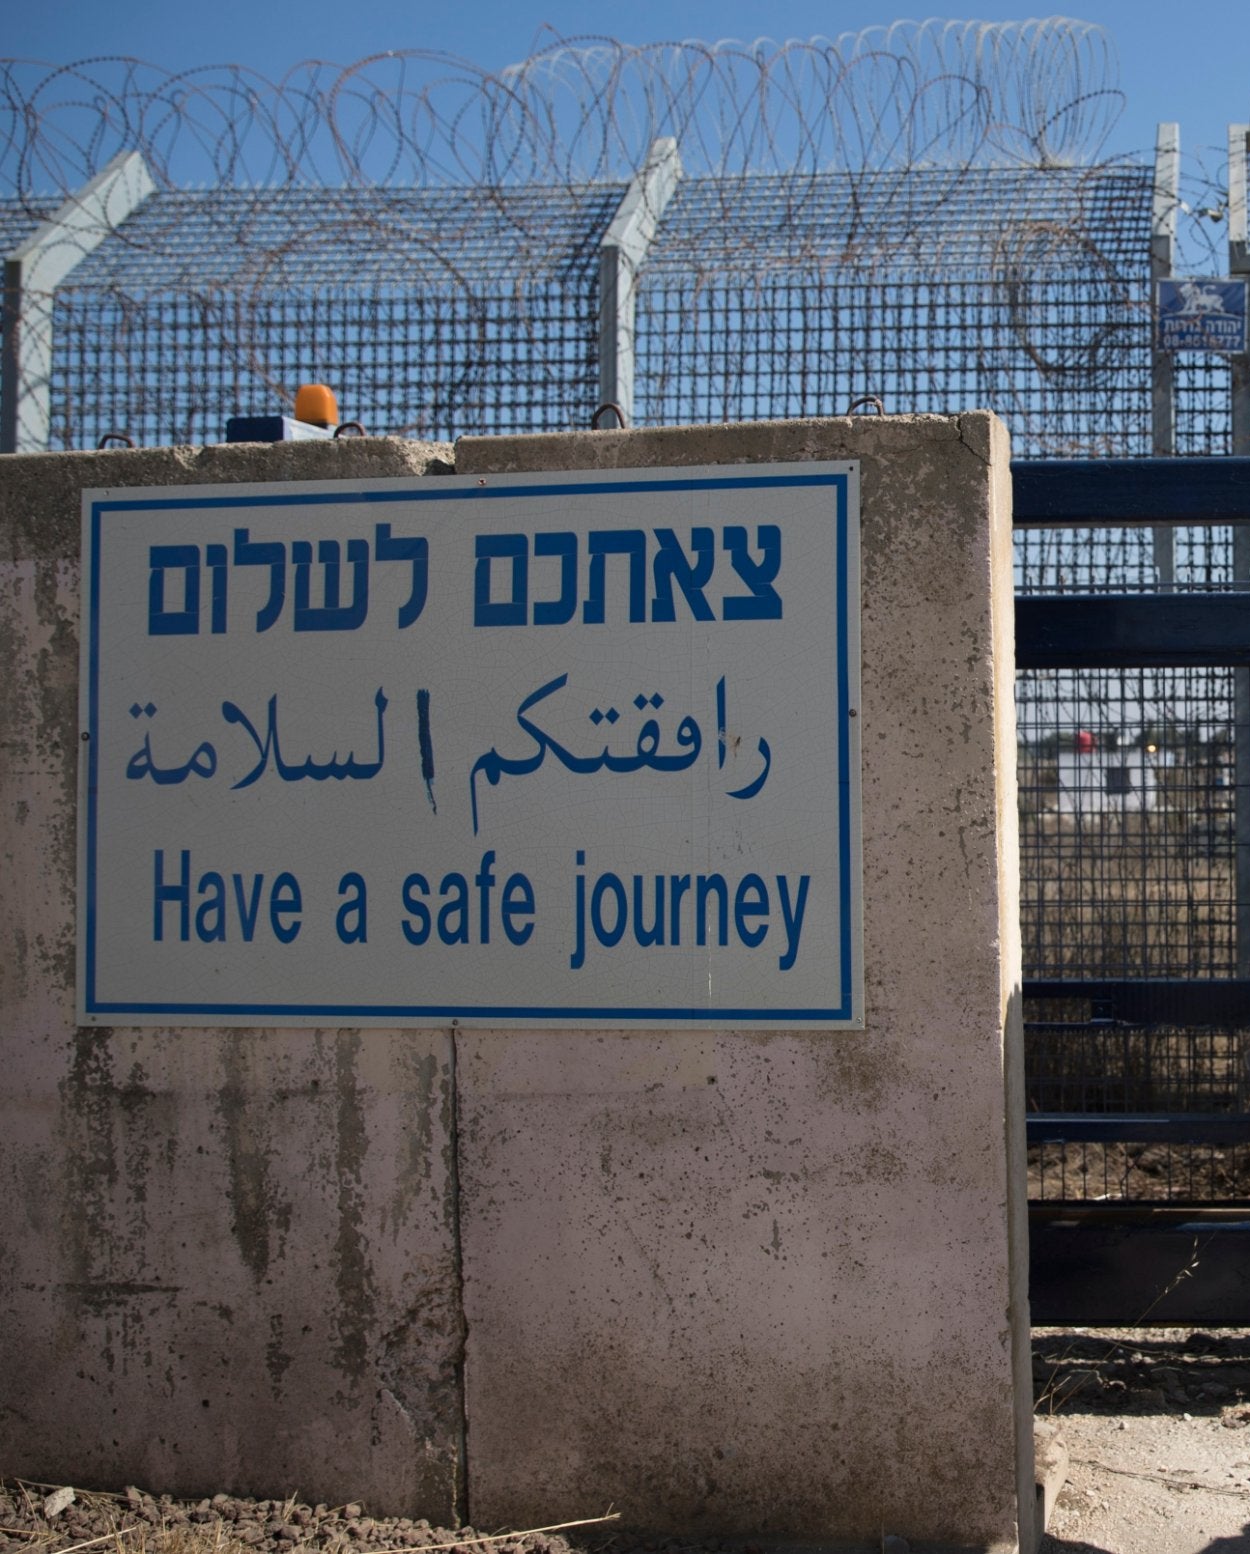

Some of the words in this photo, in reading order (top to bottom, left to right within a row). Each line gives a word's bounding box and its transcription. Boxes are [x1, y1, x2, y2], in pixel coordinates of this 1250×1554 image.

[148, 523, 429, 635] לשלום
[474, 524, 783, 629] צאתכם
[126, 686, 437, 816] السلامة
[470, 673, 771, 835] رافقتكم
[153, 850, 303, 945] Have
[335, 872, 368, 945] a
[402, 850, 536, 947] safe
[570, 850, 811, 971] journey
